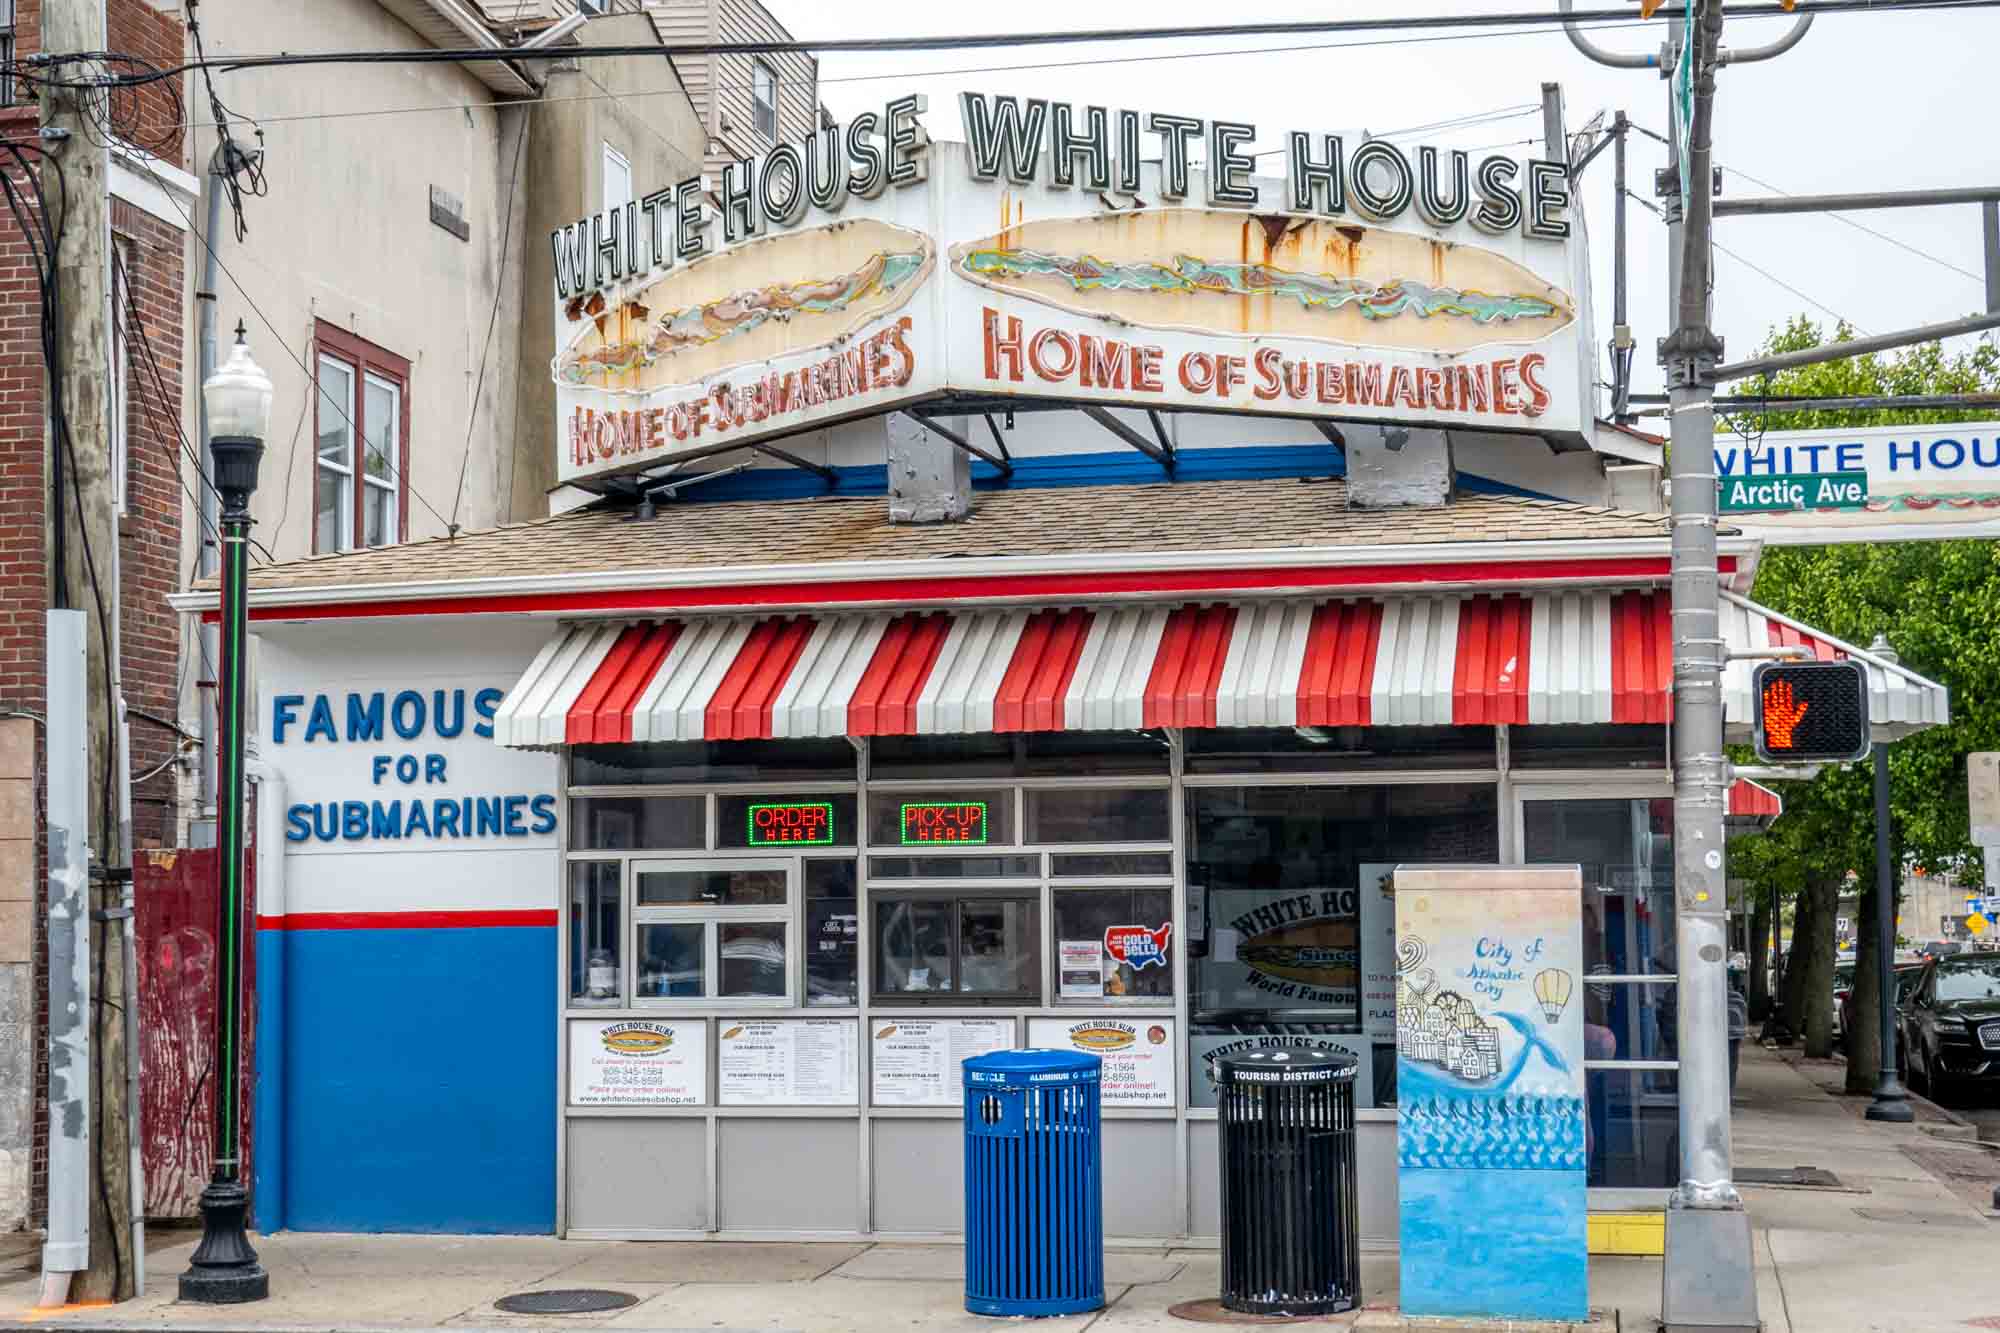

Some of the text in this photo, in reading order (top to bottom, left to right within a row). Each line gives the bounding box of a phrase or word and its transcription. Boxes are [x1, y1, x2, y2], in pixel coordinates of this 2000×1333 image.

[959, 91, 1571, 240] WHITE HOUSE
[552, 94, 926, 299] WHITE HOUSE
[983, 306, 1551, 418] HOME OF SUBMARINES
[568, 316, 914, 466] HOME OF SUBMARINES
[1730, 478, 1868, 505] Arctic Ave.
[272, 688, 505, 744] FAMOUS
[372, 754, 448, 785] FOR
[286, 794, 558, 842] SUBMARINES
[756, 807, 826, 827] ORDER
[906, 807, 981, 826] PICK-UP
[767, 828, 816, 840] HERE
[920, 828, 969, 840] HERE
[1230, 895, 1313, 937] WHITE
[1476, 936, 1544, 966] City of
[1246, 970, 1296, 997] World
[1474, 981, 1503, 1001] City
[627, 1022, 653, 1030] HOUSE
[1069, 1021, 1137, 1034] WHITE HOUSE SUBS
[1258, 1036, 1313, 1049] HOUSE
[972, 1071, 1006, 1082] RECYCLE
[1030, 1072, 1070, 1081] ALUMINUM
[1234, 1071, 1280, 1081] TOURISM
[1283, 1070, 1331, 1081] DISTRICT
[579, 1095, 696, 1104] www.whitehousesubshop.net
